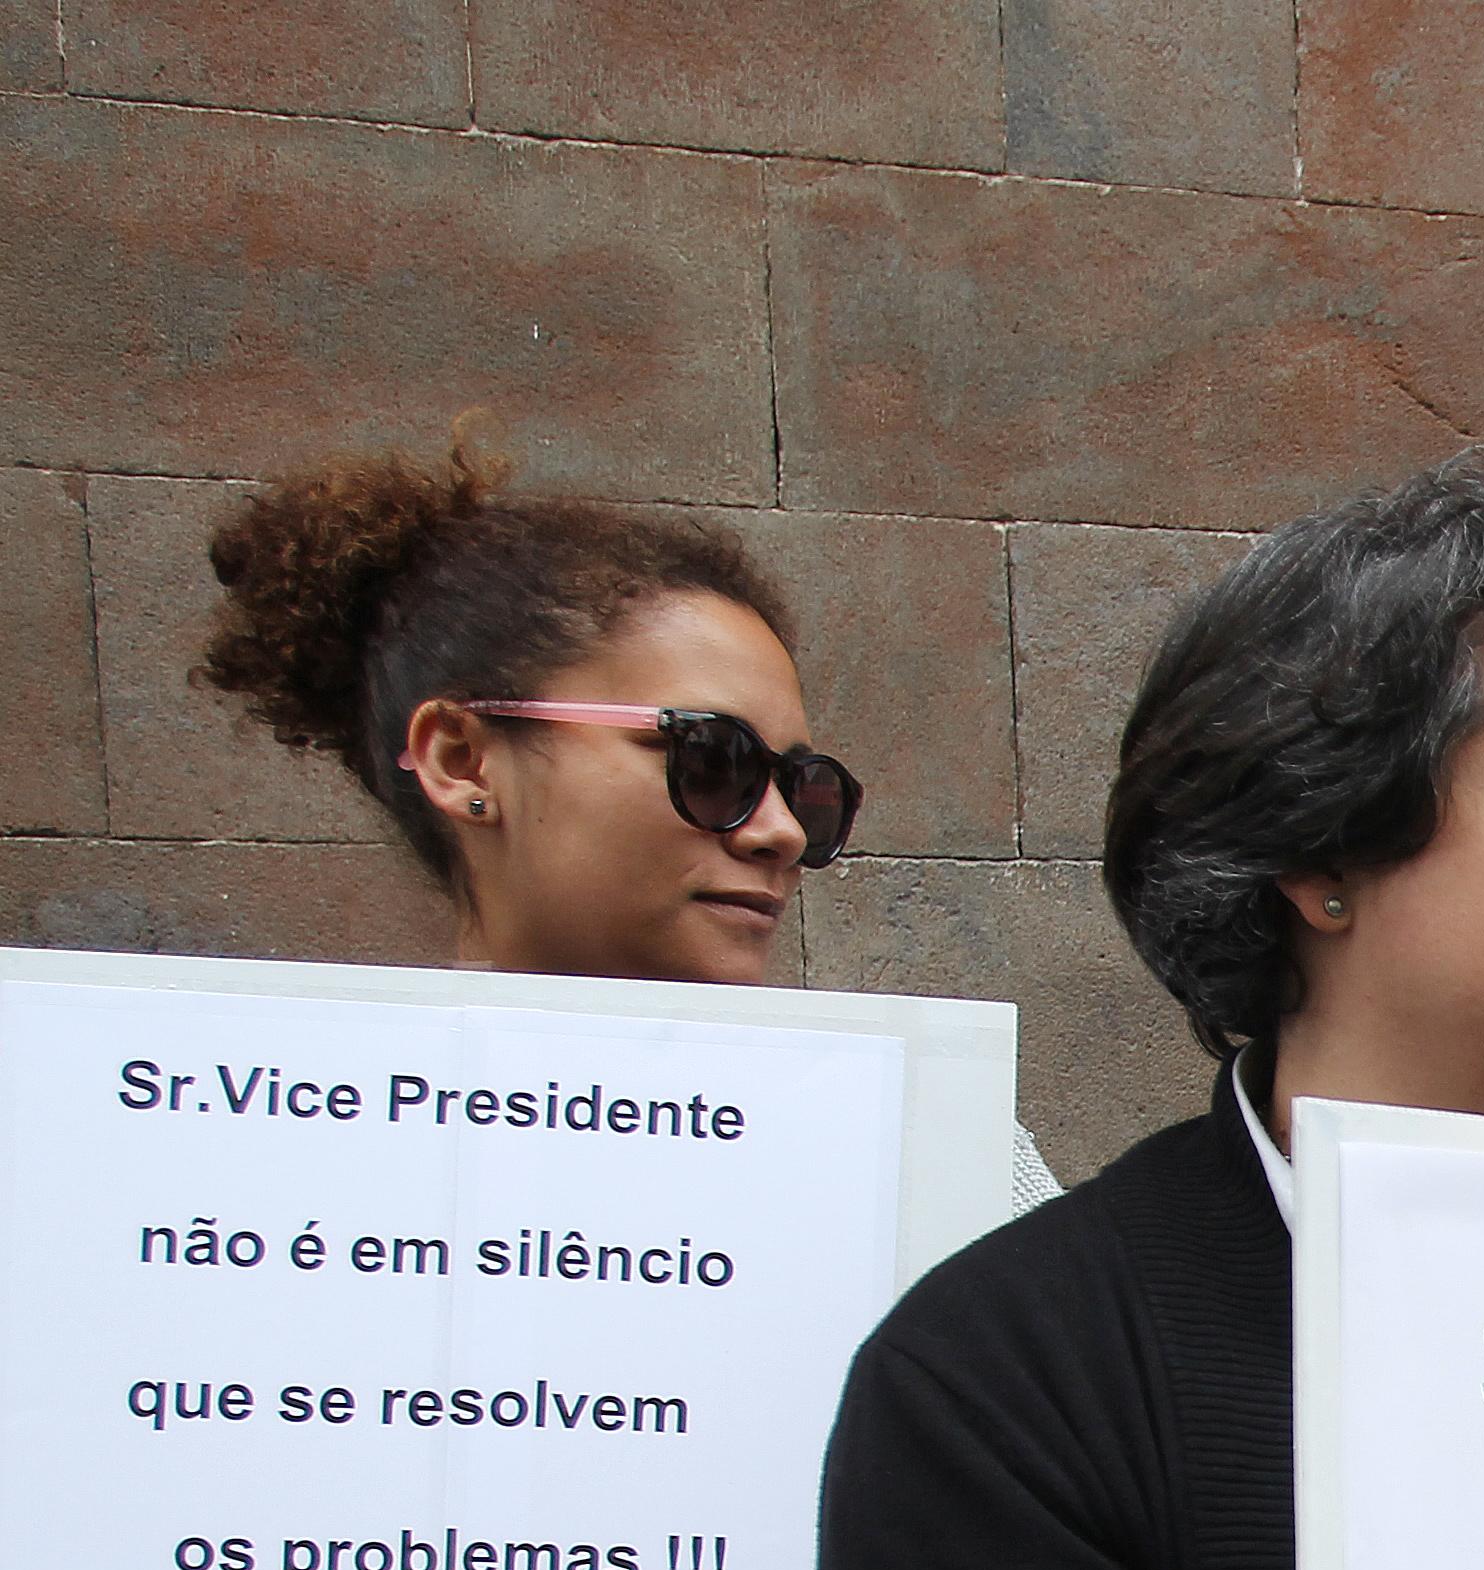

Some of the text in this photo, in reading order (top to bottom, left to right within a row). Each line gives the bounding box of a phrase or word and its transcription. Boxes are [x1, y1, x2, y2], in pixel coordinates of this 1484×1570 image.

[119, 1061, 744, 1140] Sr.Vice Presidente
[142, 1218, 733, 1286] não é em silêncio
[129, 1380, 687, 1433] que se resolvem
